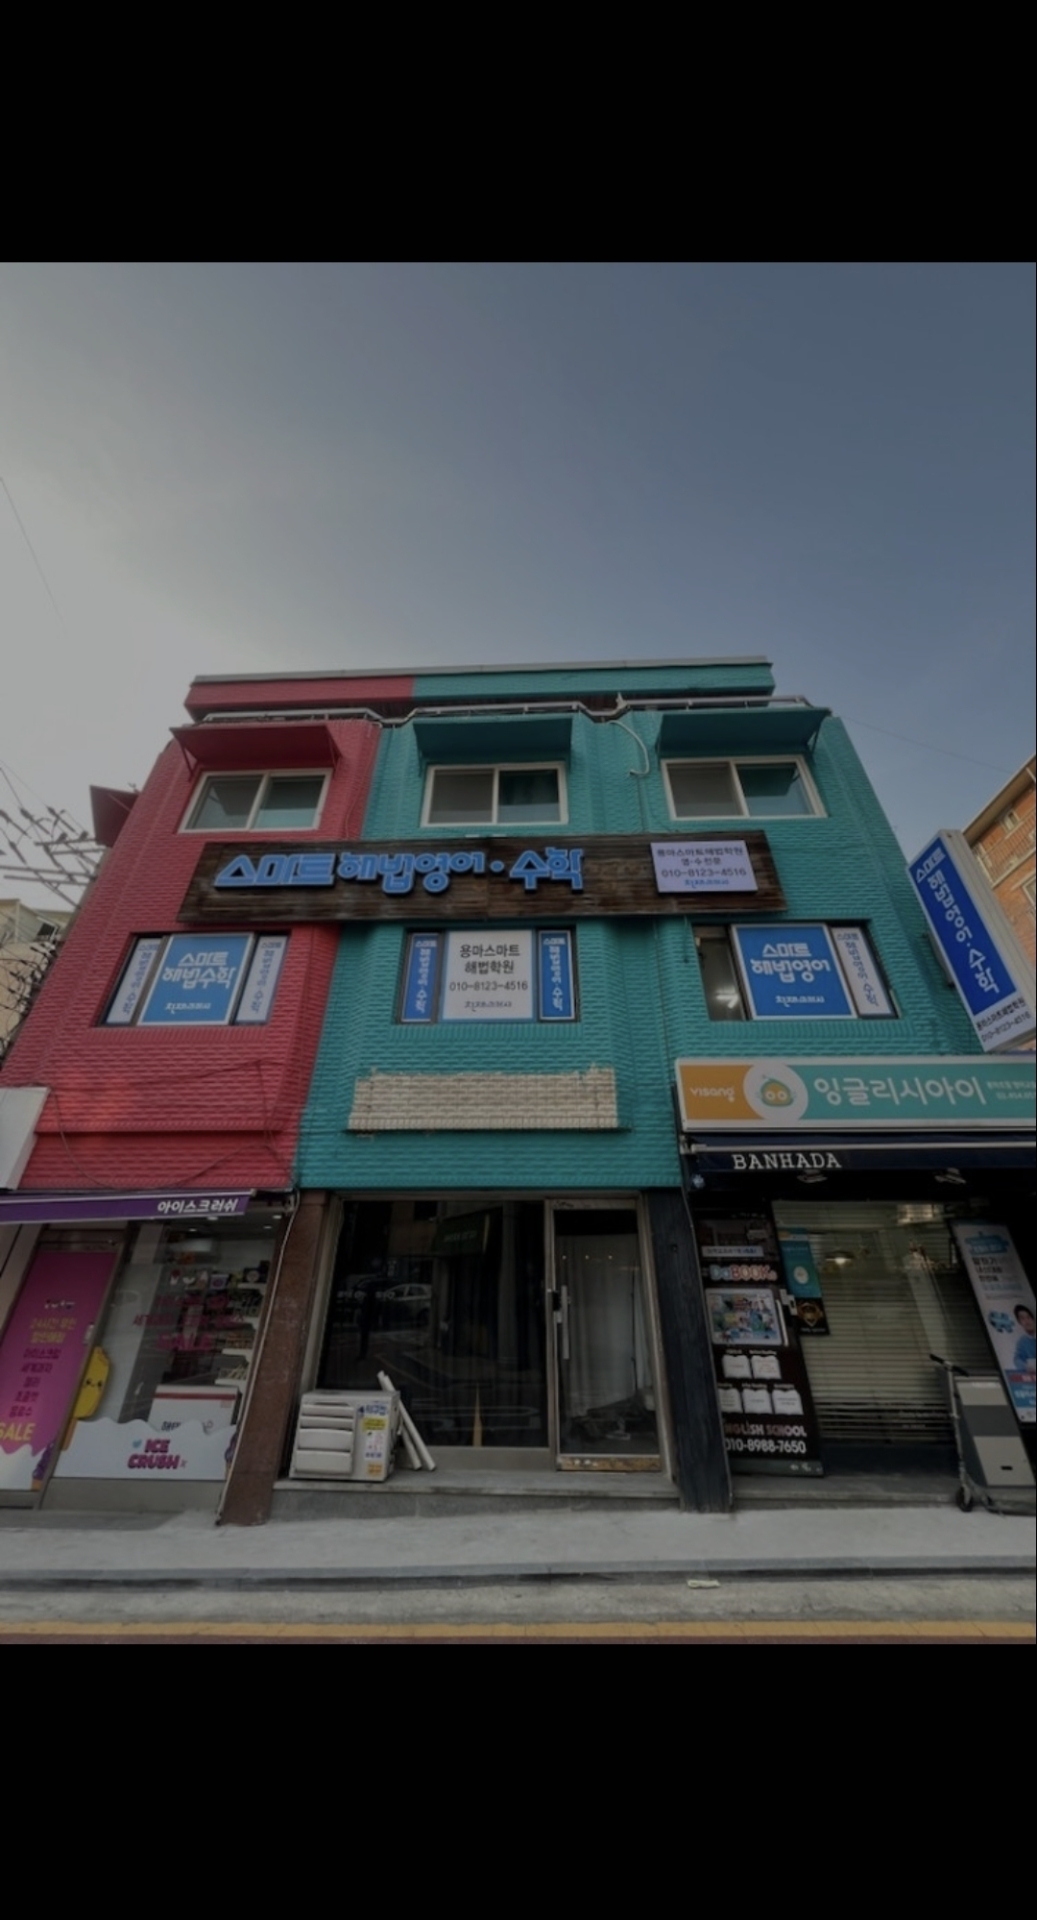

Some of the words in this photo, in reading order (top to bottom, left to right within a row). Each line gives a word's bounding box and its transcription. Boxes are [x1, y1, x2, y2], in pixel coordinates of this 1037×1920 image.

[915, 846, 946, 883] 스마트
[661, 868, 747, 878] 010-8123-4516
[415, 940, 437, 948] 스마트
[543, 938, 565, 947] 스마트
[460, 944, 520, 959] 용마스마트
[762, 943, 812, 958] 스마트
[178, 951, 228, 966] 스마트
[464, 960, 516, 975] 해법학원
[750, 959, 830, 983] 해법영어
[162, 967, 236, 989] 해법수학
[449, 981, 528, 992] 010-8123-4516
[689, 1086, 735, 1102] visang
[813, 1076, 987, 1106] 잉글리시아이
[731, 1153, 843, 1170] BANHADA
[157, 1199, 238, 1213] 아이스크러쉬
[0, 1422, 36, 1441] SALE
[766, 1425, 808, 1438] SCHOOL
[145, 1439, 171, 1453] ICE
[128, 1454, 180, 1469] CRUSH
